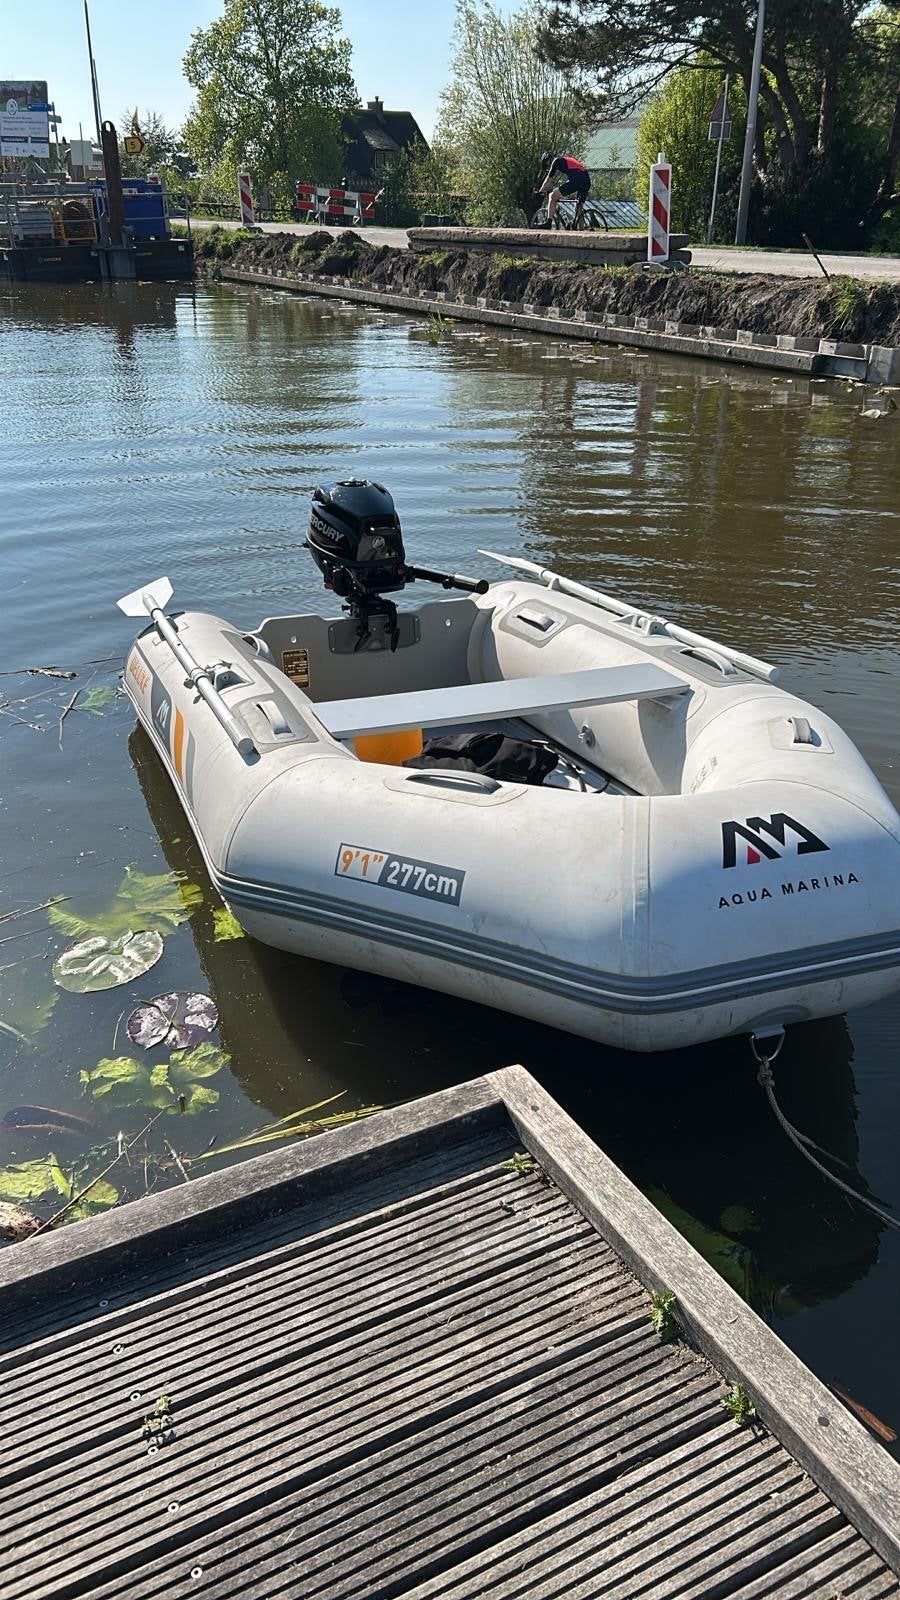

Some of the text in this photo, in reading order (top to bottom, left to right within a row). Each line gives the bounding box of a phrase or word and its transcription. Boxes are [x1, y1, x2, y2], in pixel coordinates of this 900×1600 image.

[130, 141, 136, 150] 5
[310, 513, 345, 542] ERCURY
[386, 861, 458, 897] 277cm
[718, 872, 860, 909] AQUA MARINA
